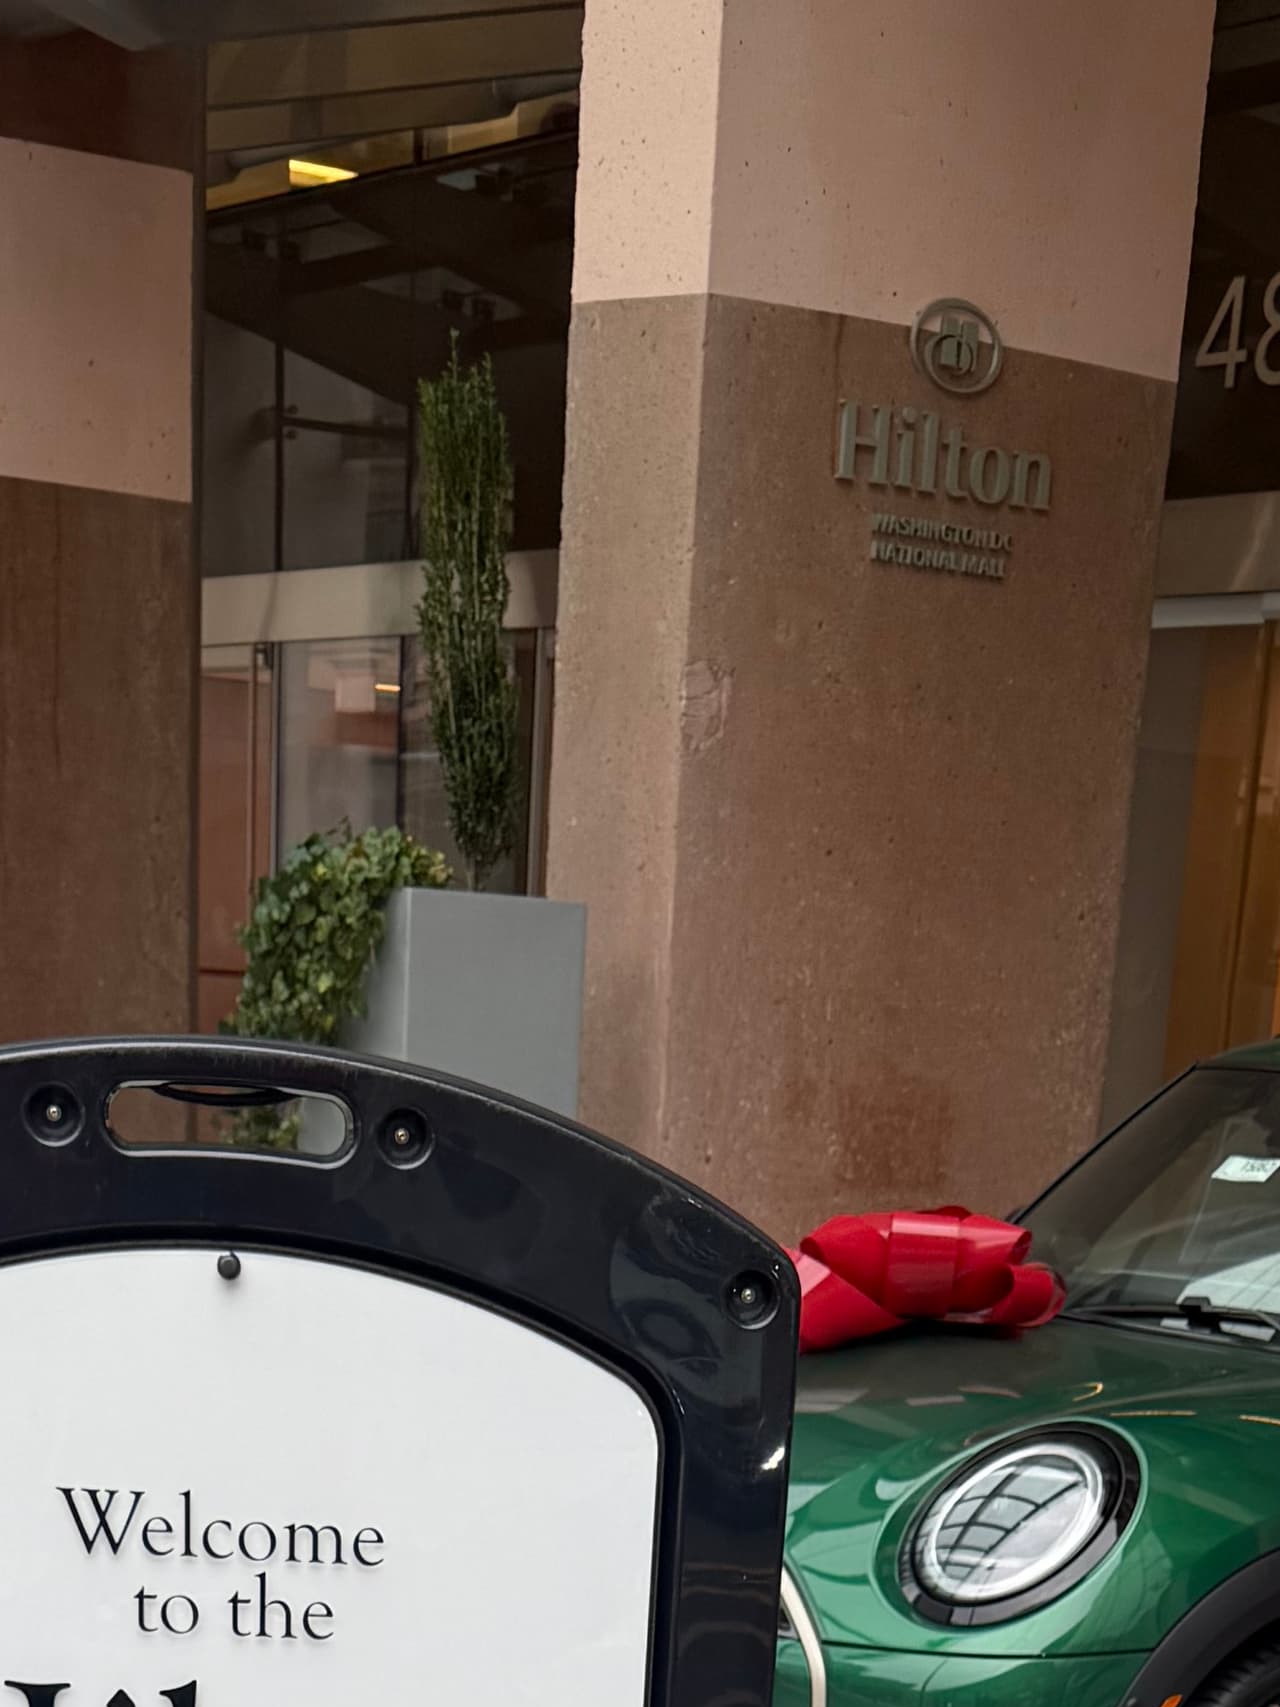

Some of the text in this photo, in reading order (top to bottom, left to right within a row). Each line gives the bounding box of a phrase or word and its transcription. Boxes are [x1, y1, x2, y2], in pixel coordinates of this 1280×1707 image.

[835, 398, 1052, 511] Hilton
[871, 514, 987, 547] WASHINGTON
[871, 540, 1006, 577] NATIONAL MALL
[56, 1487, 385, 1567] Welcome
[135, 1571, 335, 1640] to the
